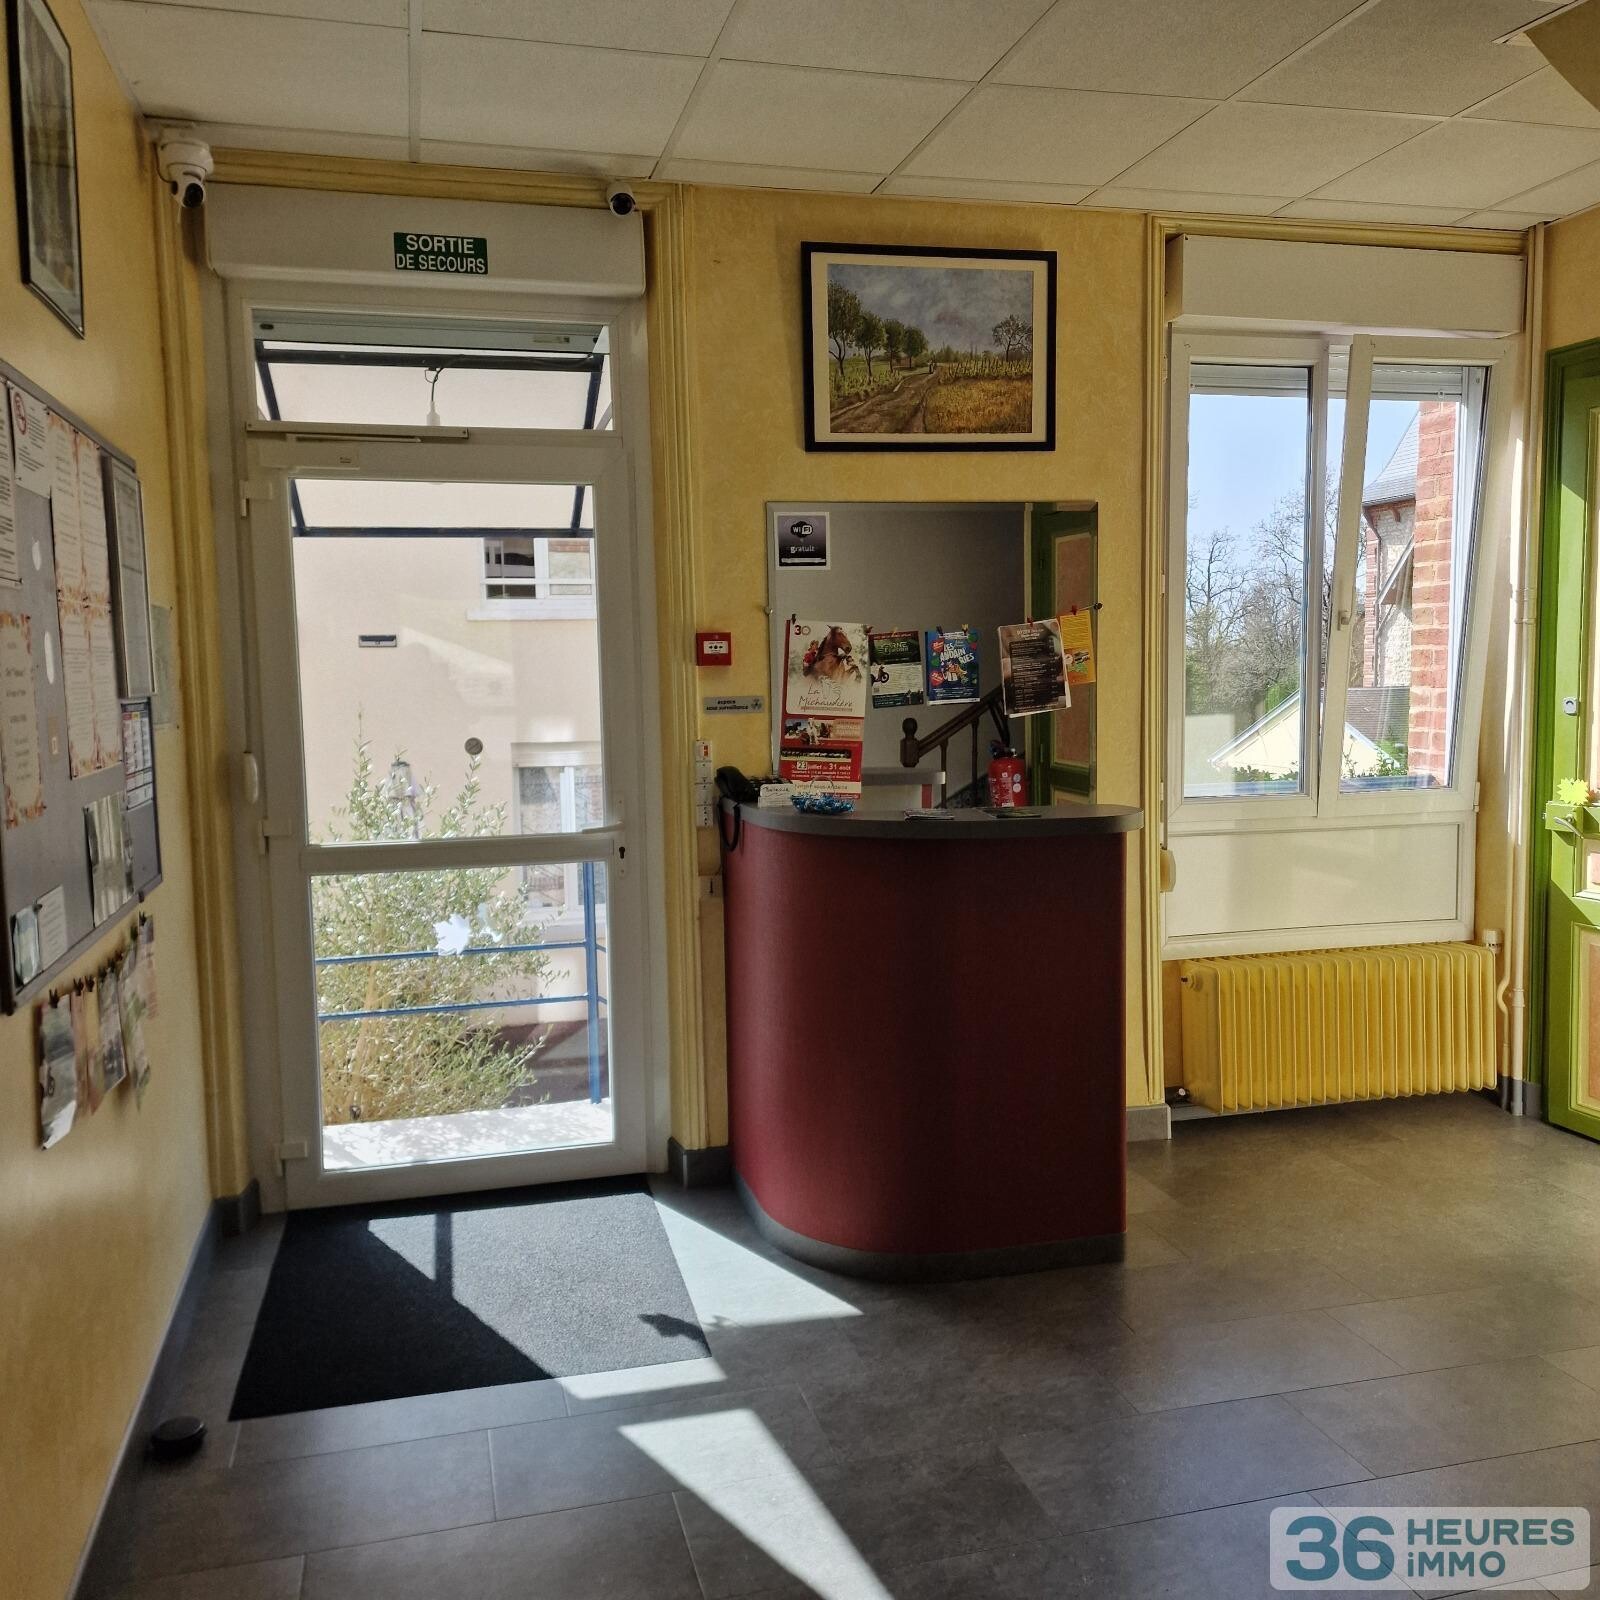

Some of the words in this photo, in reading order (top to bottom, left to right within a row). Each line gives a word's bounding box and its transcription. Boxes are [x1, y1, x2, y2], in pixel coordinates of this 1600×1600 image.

[406, 235, 474, 254] SORTIE
[396, 254, 415, 268] DE
[419, 254, 485, 273] SECOURS
